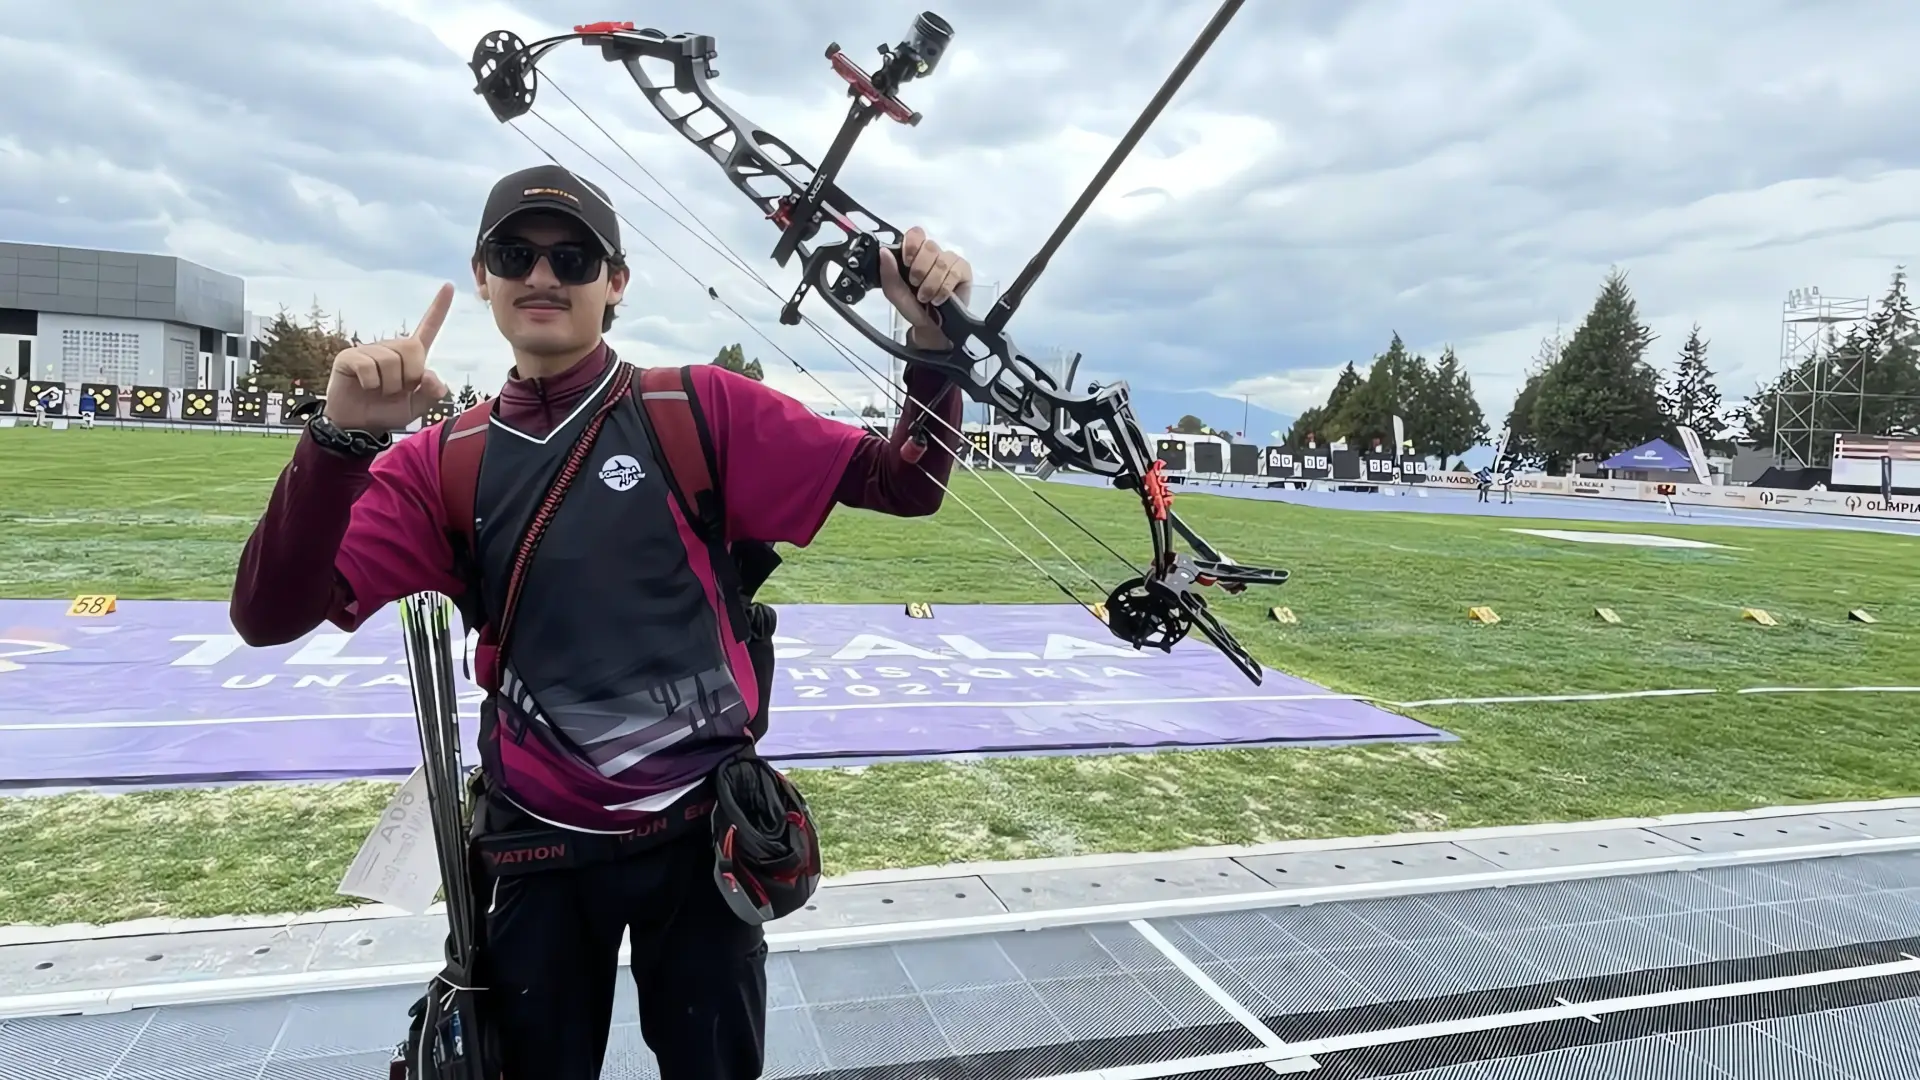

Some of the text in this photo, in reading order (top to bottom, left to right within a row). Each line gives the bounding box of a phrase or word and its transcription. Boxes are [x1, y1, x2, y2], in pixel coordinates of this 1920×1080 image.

[73, 596, 106, 614] 58
[910, 602, 933, 619] 61
[787, 666, 1146, 681] HISTORIA
[793, 682, 972, 698] 2027
